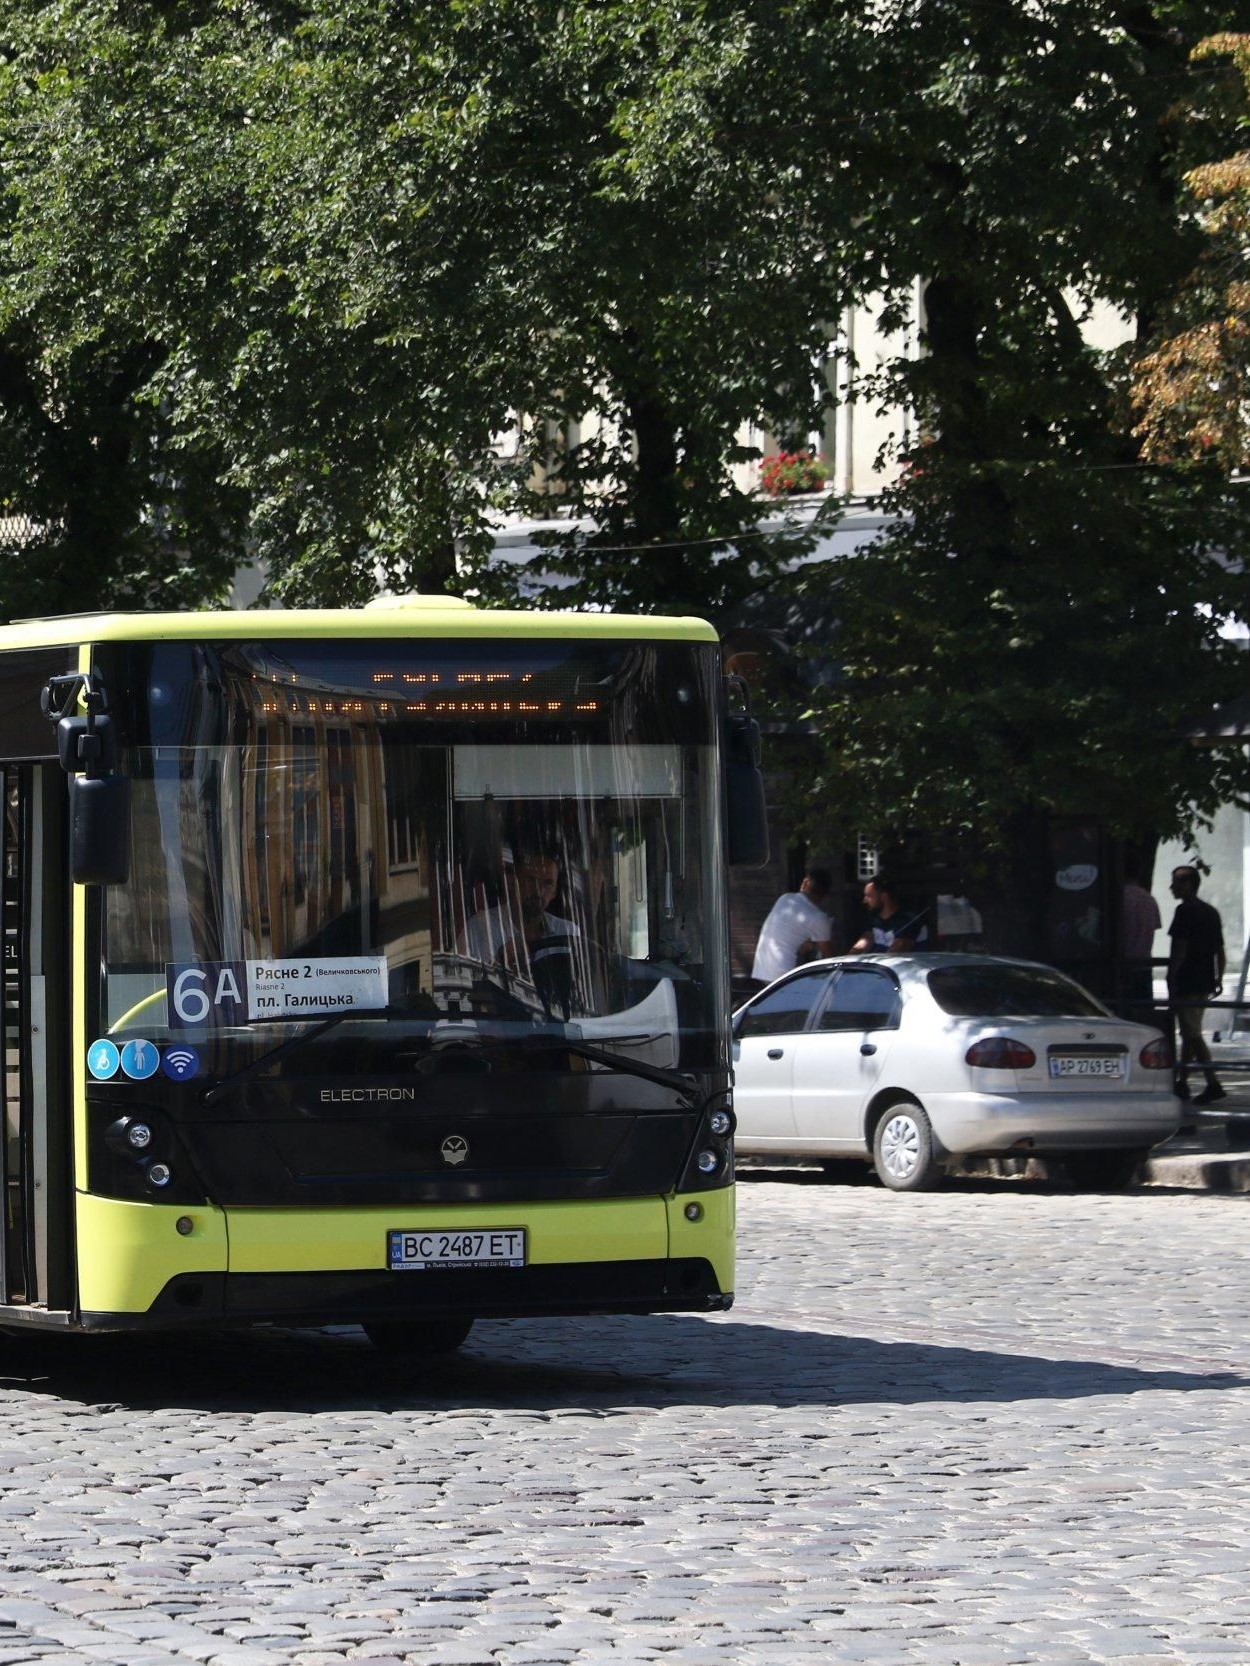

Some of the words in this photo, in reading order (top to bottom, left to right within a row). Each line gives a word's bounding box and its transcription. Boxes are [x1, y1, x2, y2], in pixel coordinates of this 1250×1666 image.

[255, 967, 299, 979] Рясне
[303, 965, 312, 978] 2
[255, 983, 279, 991] Riasne
[280, 982, 285, 990] 2
[257, 997, 280, 1008] пл.
[320, 1088, 415, 1102] ELECTRON
[405, 1236, 433, 1258] BC
[439, 1235, 484, 1257] 2487
[490, 1234, 518, 1256] ET
